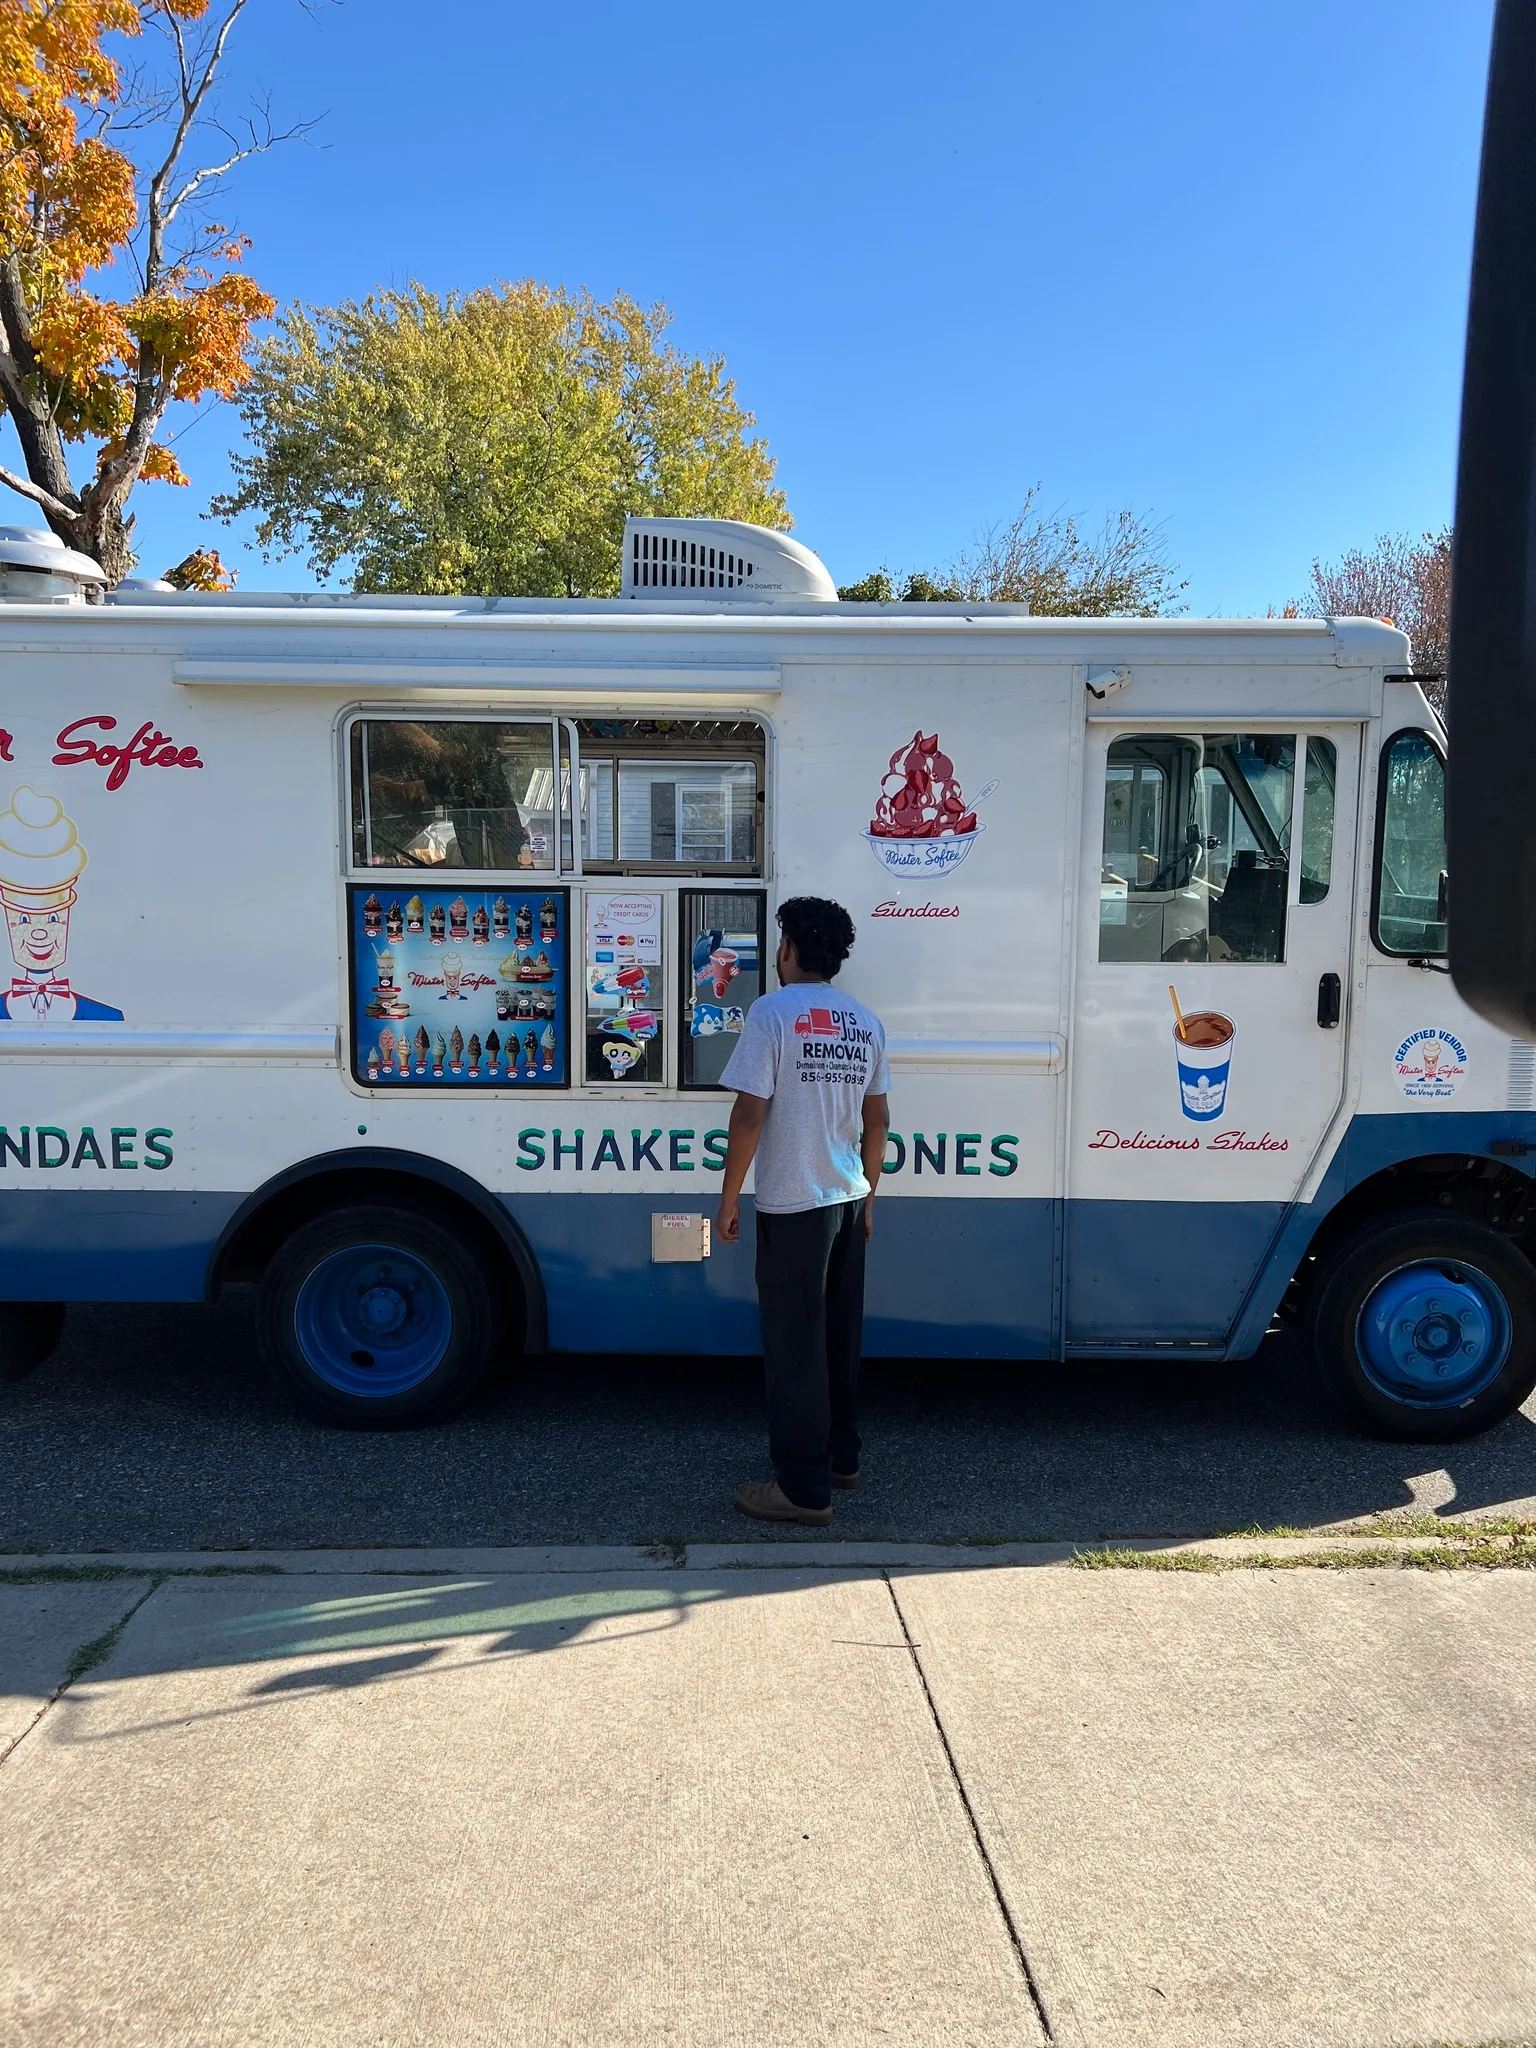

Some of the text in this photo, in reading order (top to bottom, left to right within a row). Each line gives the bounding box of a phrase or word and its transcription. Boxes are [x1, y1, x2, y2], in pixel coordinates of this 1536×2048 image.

[52, 715, 203, 791] Softee
[885, 847, 960, 868] Mister Softee
[871, 901, 960, 917] Sundaes
[407, 971, 497, 991] Mister Softee
[803, 1042, 868, 1063] REMOVAL
[1395, 1029, 1436, 1062] CERTIFIED
[1438, 1030, 1467, 1062] VENDOR
[1396, 1063, 1464, 1078] Mister Softee
[1418, 1088, 1434, 1097] Very
[0, 1125, 174, 1170] NDAES
[1087, 1129, 1289, 1151] Delicious Shakes
[515, 1127, 1019, 1177] SHAKES ONES
